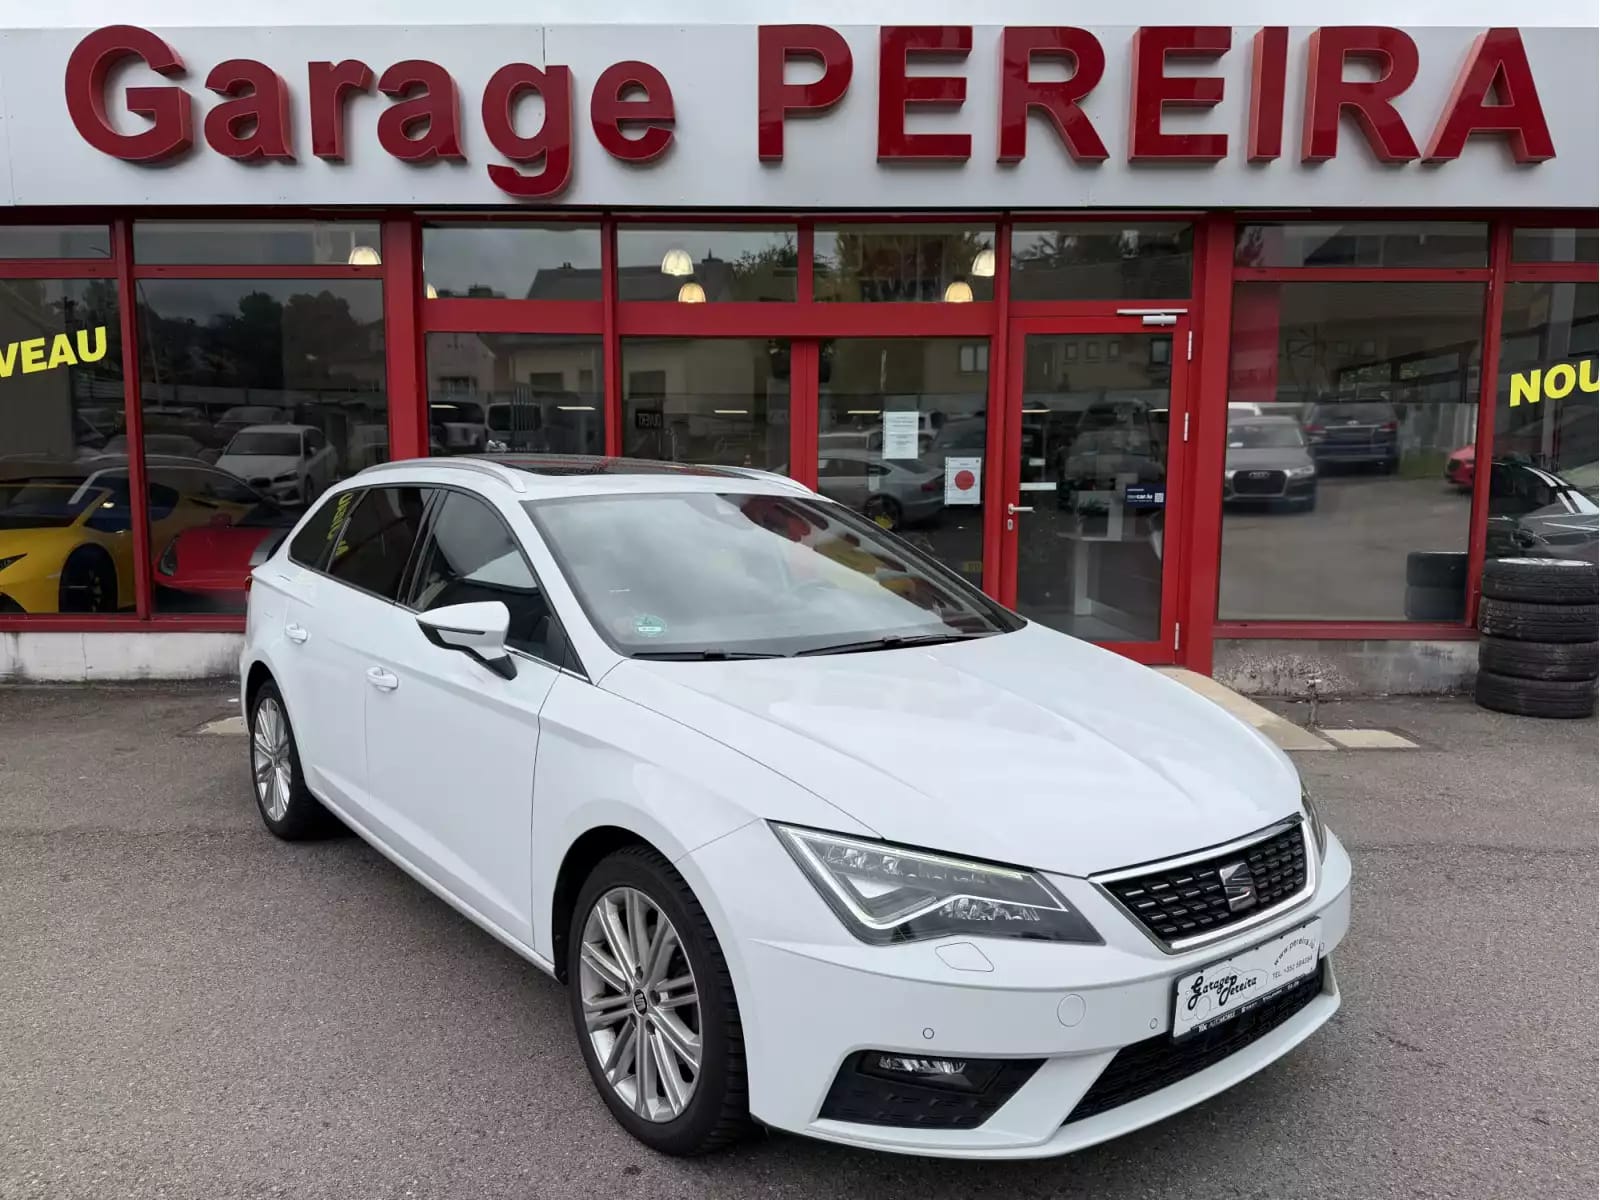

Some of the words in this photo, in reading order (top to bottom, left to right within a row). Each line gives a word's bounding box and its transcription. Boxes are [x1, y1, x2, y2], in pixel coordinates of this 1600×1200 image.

[65, 24, 677, 198] Garage
[758, 24, 1556, 163] PEREIRA
[0, 326, 107, 378] VEAU
[1509, 359, 1600, 407] NOU
[1187, 975, 1231, 1011] Garage
[1218, 975, 1257, 1007] Pereira
